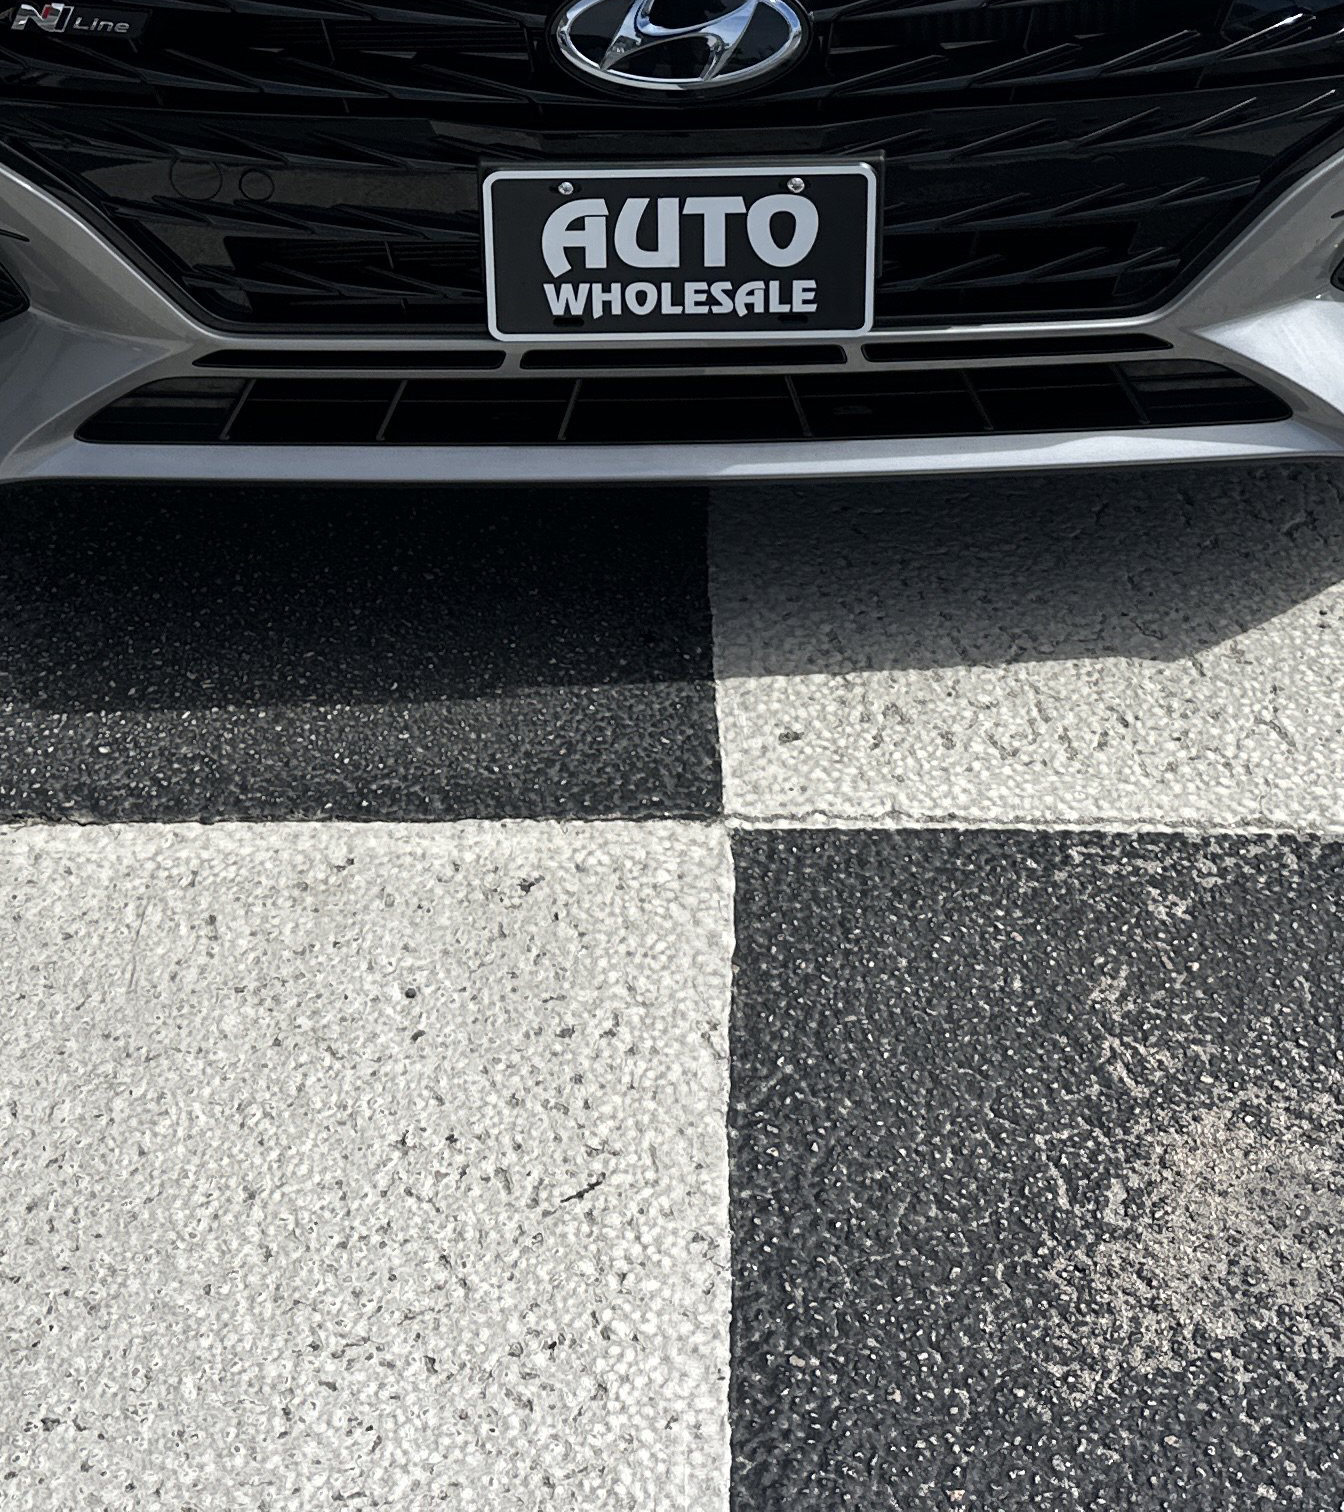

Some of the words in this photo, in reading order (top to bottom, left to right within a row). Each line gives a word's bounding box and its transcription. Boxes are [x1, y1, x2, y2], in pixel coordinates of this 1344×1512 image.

[73, 16, 130, 33] Line
[541, 193, 819, 278] AUTO
[543, 279, 818, 320] WHOLESALE
